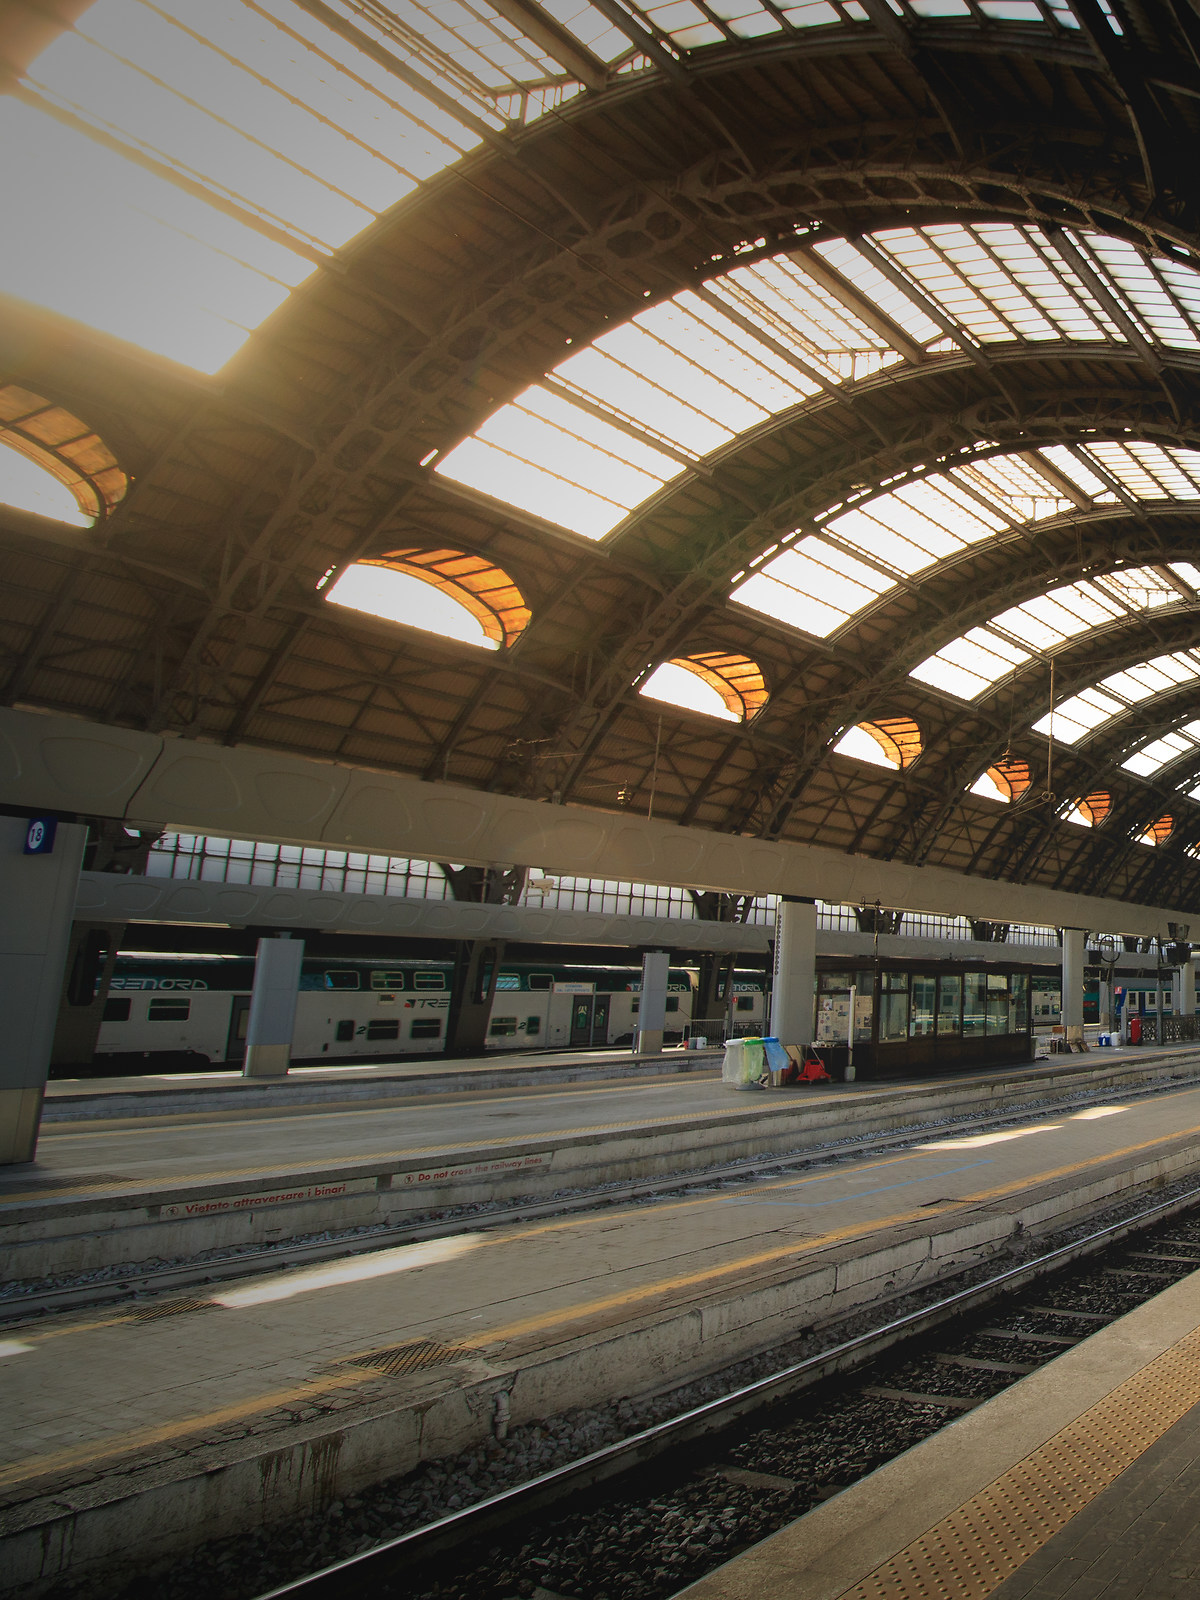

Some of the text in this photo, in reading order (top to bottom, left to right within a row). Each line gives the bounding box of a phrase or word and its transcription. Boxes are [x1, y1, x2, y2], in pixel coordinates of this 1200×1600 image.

[30, 827, 43, 843] 18
[108, 978, 208, 991] RENORD
[417, 998, 450, 1008] TRE
[355, 1025, 367, 1035] 2
[517, 1021, 527, 1030] 2
[418, 1156, 543, 1182] Do not cross the railway lines
[185, 1184, 346, 1214] Vietato attraversare i binari
